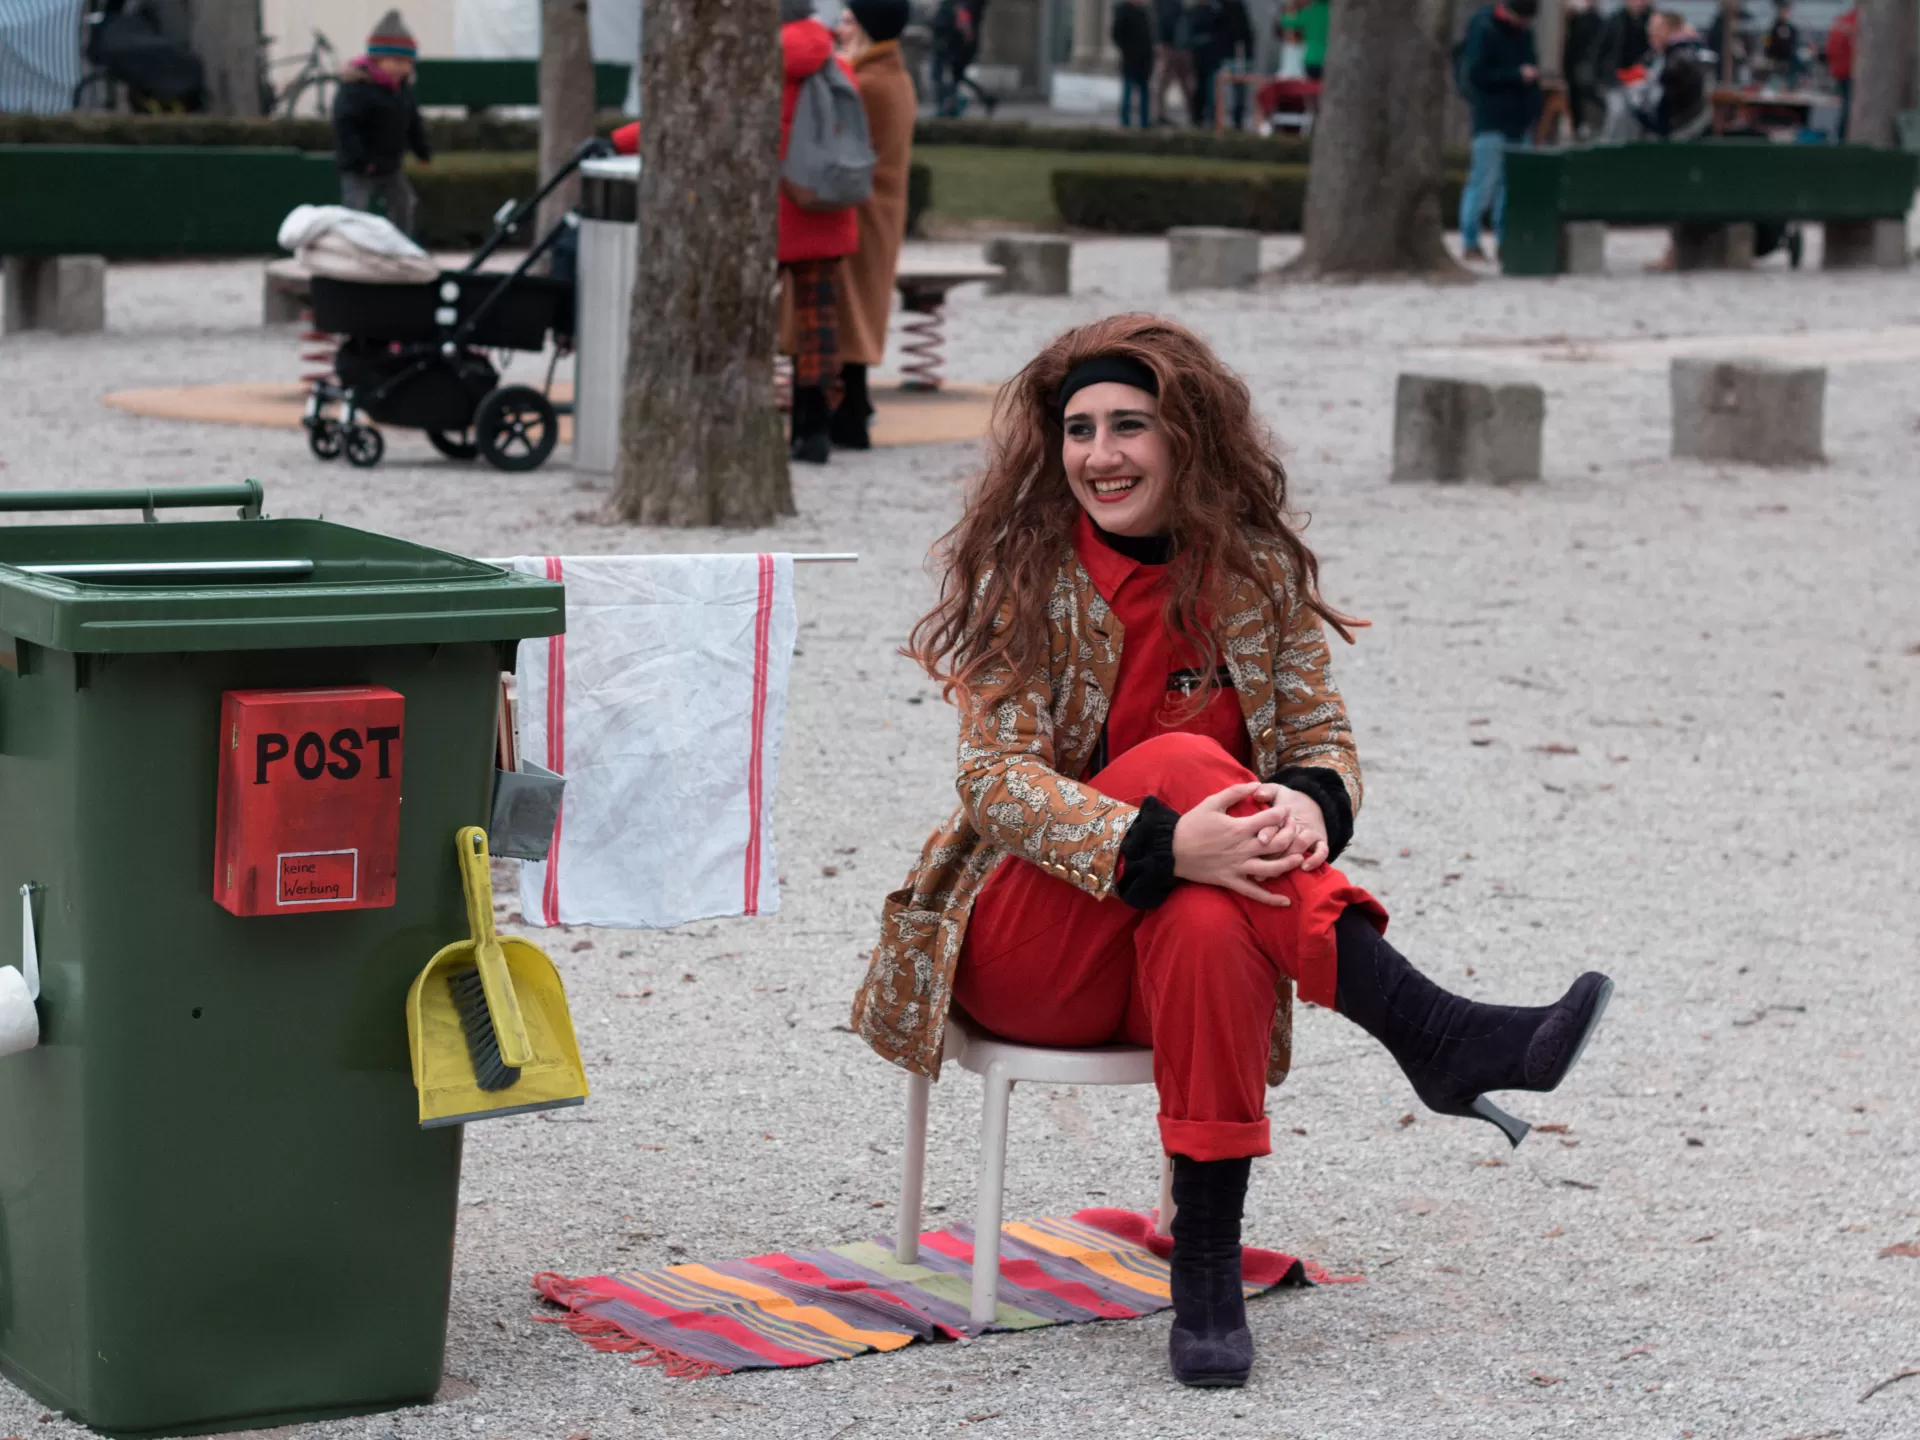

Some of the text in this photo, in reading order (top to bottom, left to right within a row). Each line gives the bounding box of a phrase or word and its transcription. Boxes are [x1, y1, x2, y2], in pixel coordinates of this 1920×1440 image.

[253, 724, 400, 785] POST
[284, 860, 316, 875] keine
[284, 879, 340, 898] Werbung
